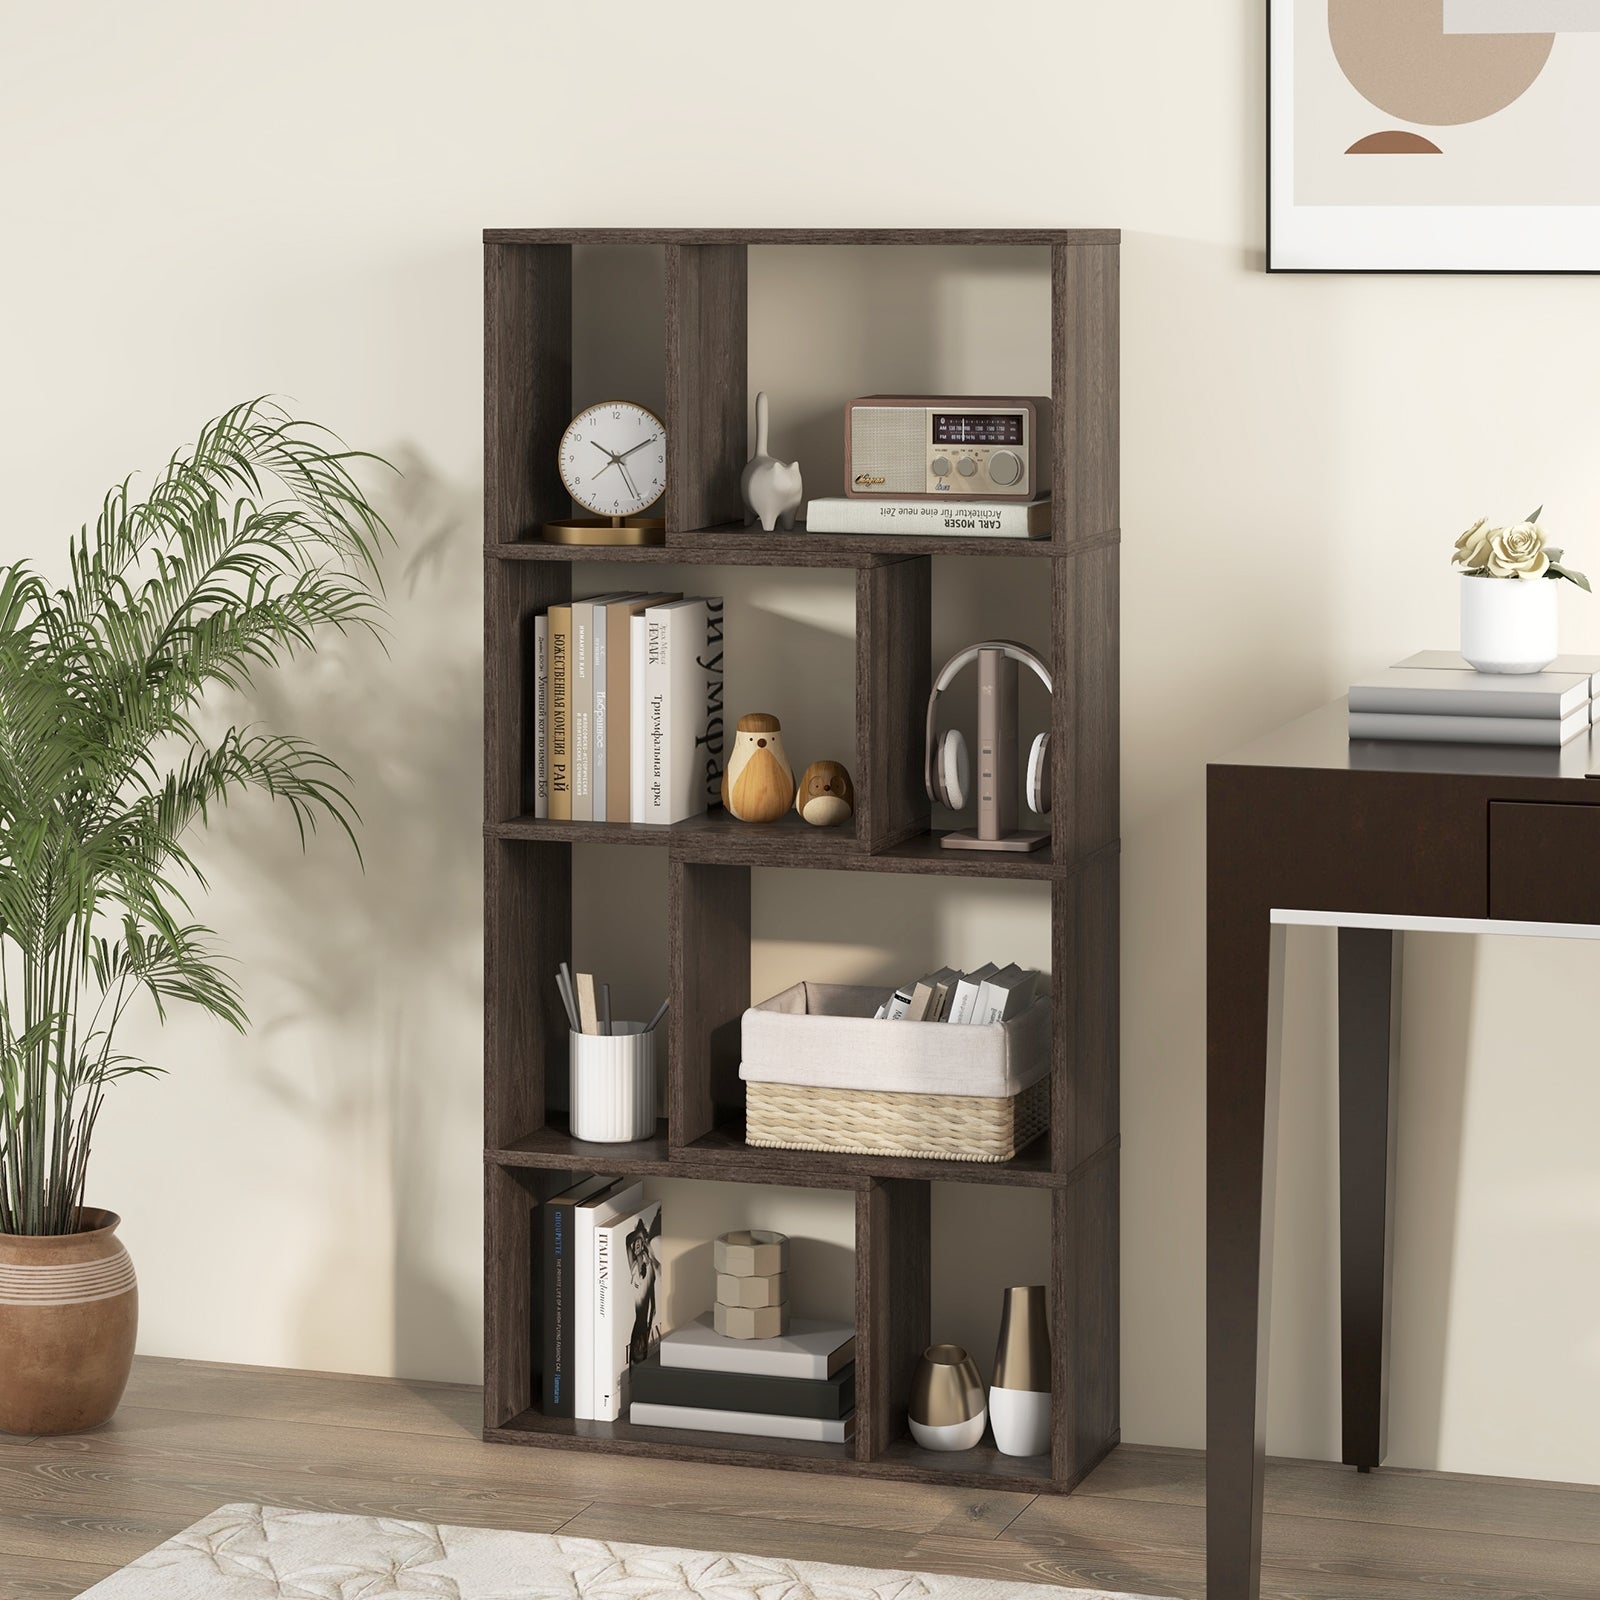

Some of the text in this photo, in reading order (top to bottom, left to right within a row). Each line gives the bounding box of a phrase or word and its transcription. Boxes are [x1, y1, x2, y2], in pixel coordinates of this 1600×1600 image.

[612, 411, 621, 420] 12
[589, 418, 597, 426] 11
[573, 433, 582, 442] 10
[652, 433, 658, 442] 2
[569, 455, 575, 463] 9
[658, 455, 664, 463] 3
[574, 477, 581, 485] 8
[652, 477, 658, 485] 4
[591, 493, 597, 501] 7
[636, 493, 642, 501] 5
[613, 499, 619, 508] 6
[880, 507, 1002, 519] Architektur für eine neue Zeit
[944, 518, 1001, 529] CARL MOSER
[538, 675, 548, 717] Уличный
[552, 633, 569, 792] БОЖЕСТВЕННАЯ КОМЕДИЯ РАЙ
[594, 691, 606, 748] Избранное
[539, 736, 545, 748] по
[651, 694, 664, 807] Триумфальная арка
[538, 780, 548, 798] Боб
